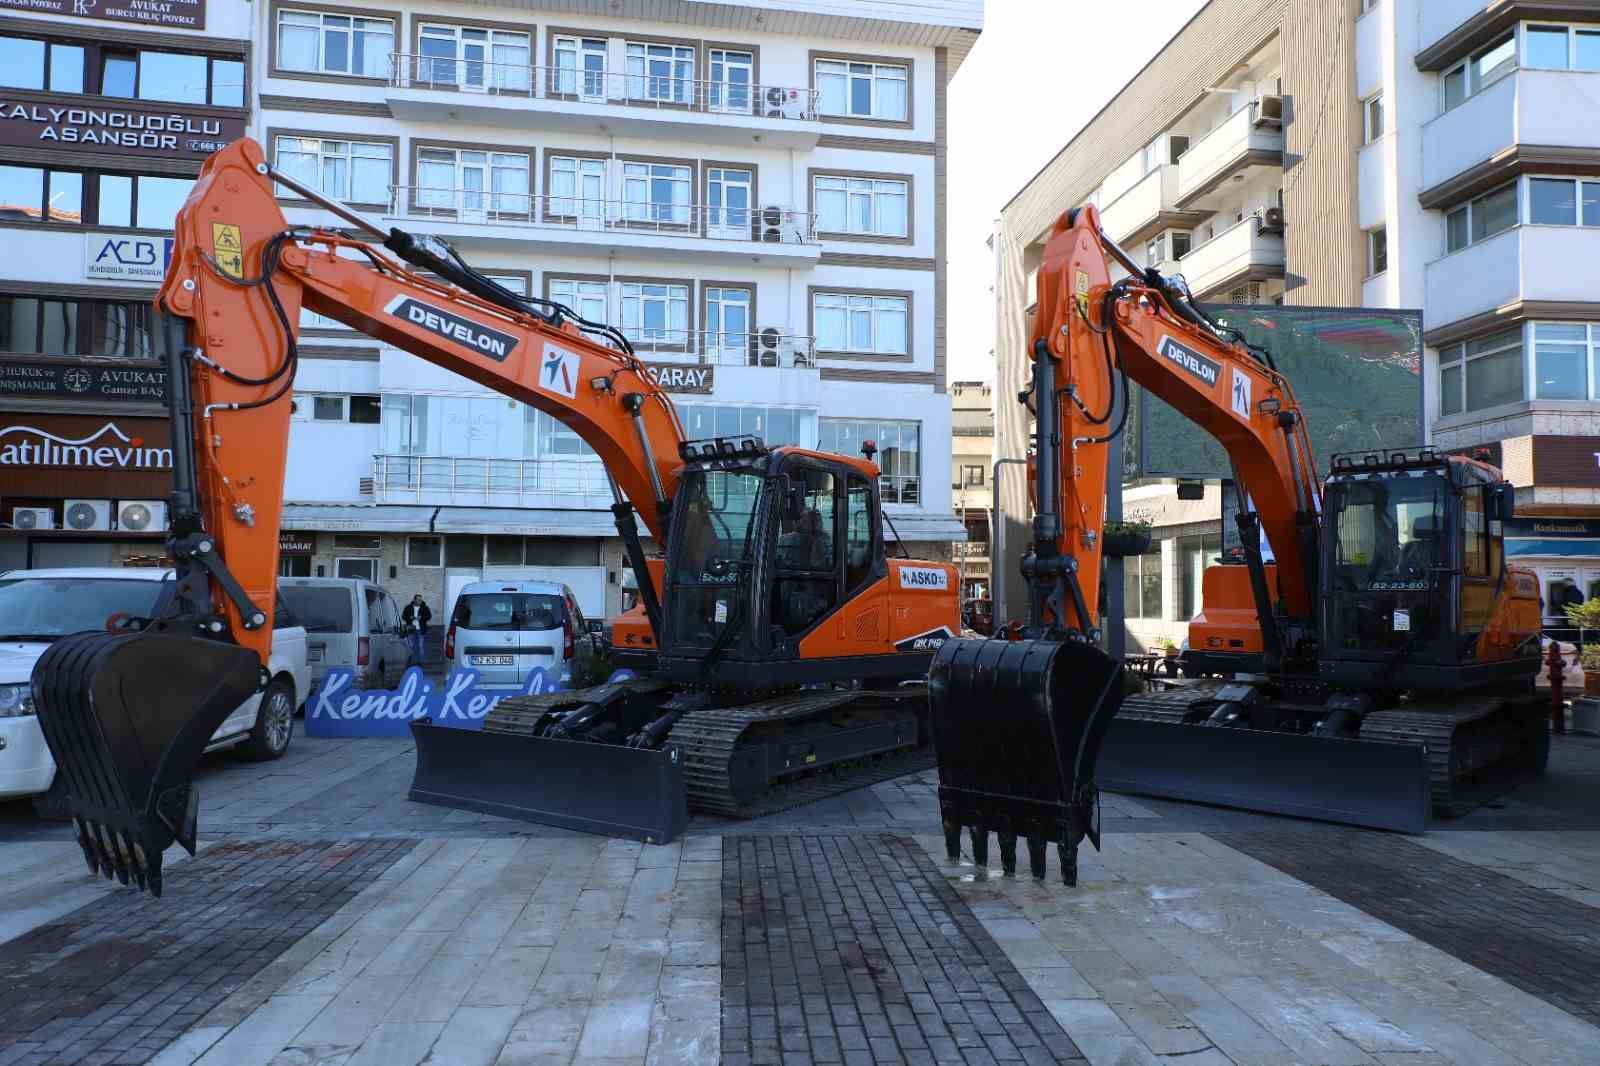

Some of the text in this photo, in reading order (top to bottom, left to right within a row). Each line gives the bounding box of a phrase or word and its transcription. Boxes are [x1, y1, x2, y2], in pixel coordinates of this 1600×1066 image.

[105, 8, 136, 18] BURCU
[130, 0, 172, 13] AVUKAT
[40, 126, 177, 149] ASANSÖR
[96, 239, 156, 265] ACB
[408, 305, 505, 356] DEVELON
[6, 367, 43, 377] HUKUK
[1168, 343, 1215, 383] DEVELON
[100, 370, 168, 384] AVUKAT
[911, 571, 938, 586] ASKO
[311, 672, 429, 720] Kendi
